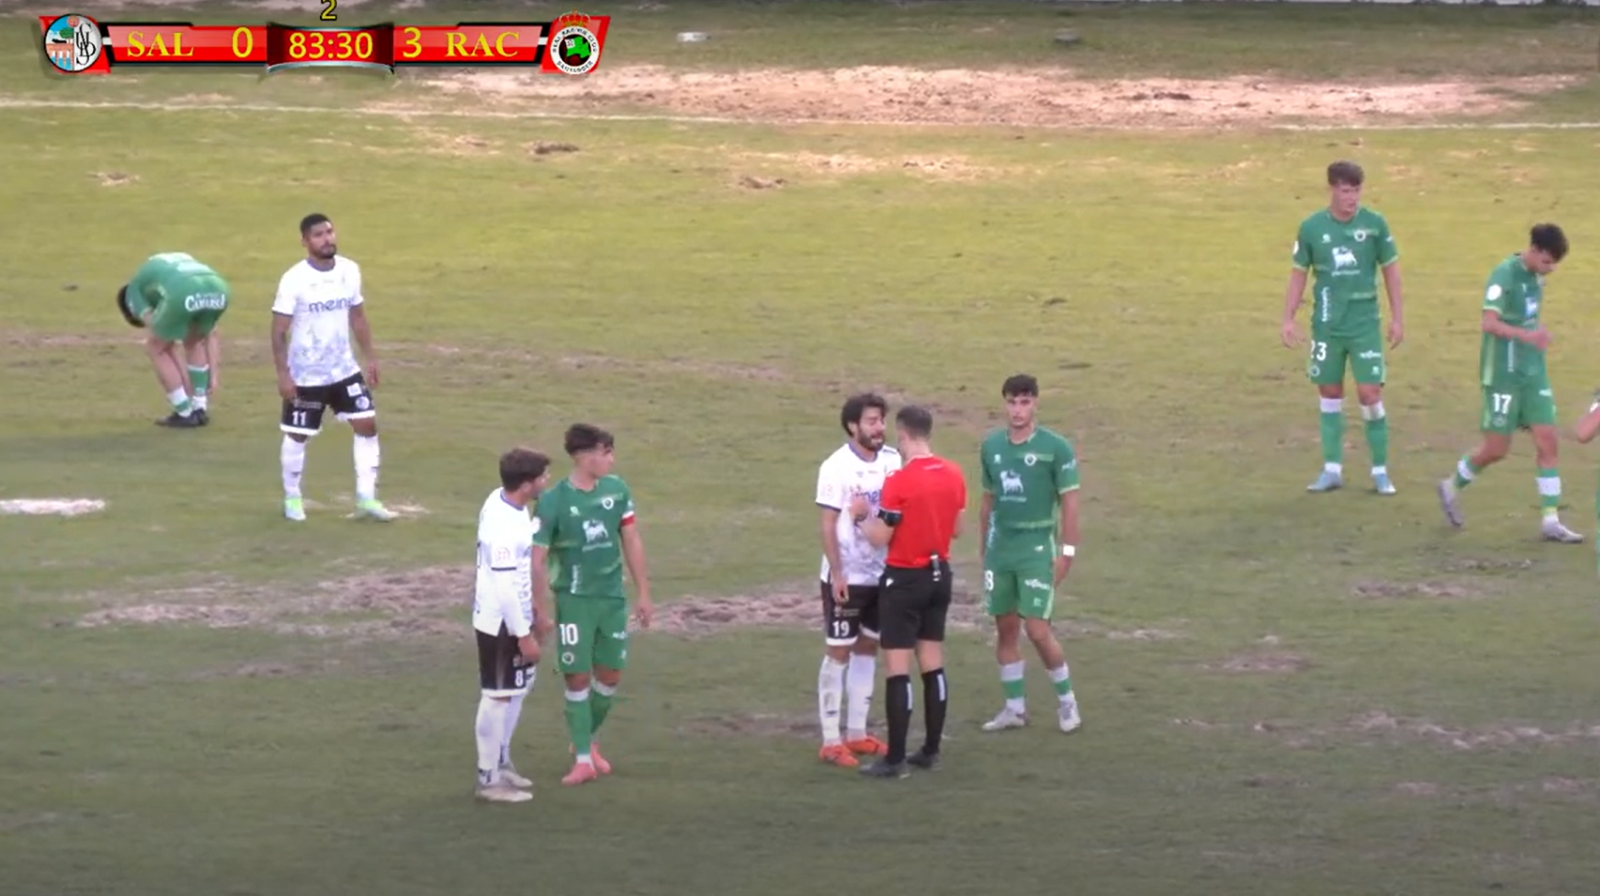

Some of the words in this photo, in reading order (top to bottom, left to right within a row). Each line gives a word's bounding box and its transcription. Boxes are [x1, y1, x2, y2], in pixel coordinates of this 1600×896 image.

[1492, 392, 1512, 414] 17
[292, 410, 307, 426] 11
[559, 623, 579, 645] 10
[832, 620, 850, 637] 19
[514, 669, 524, 687] 8
